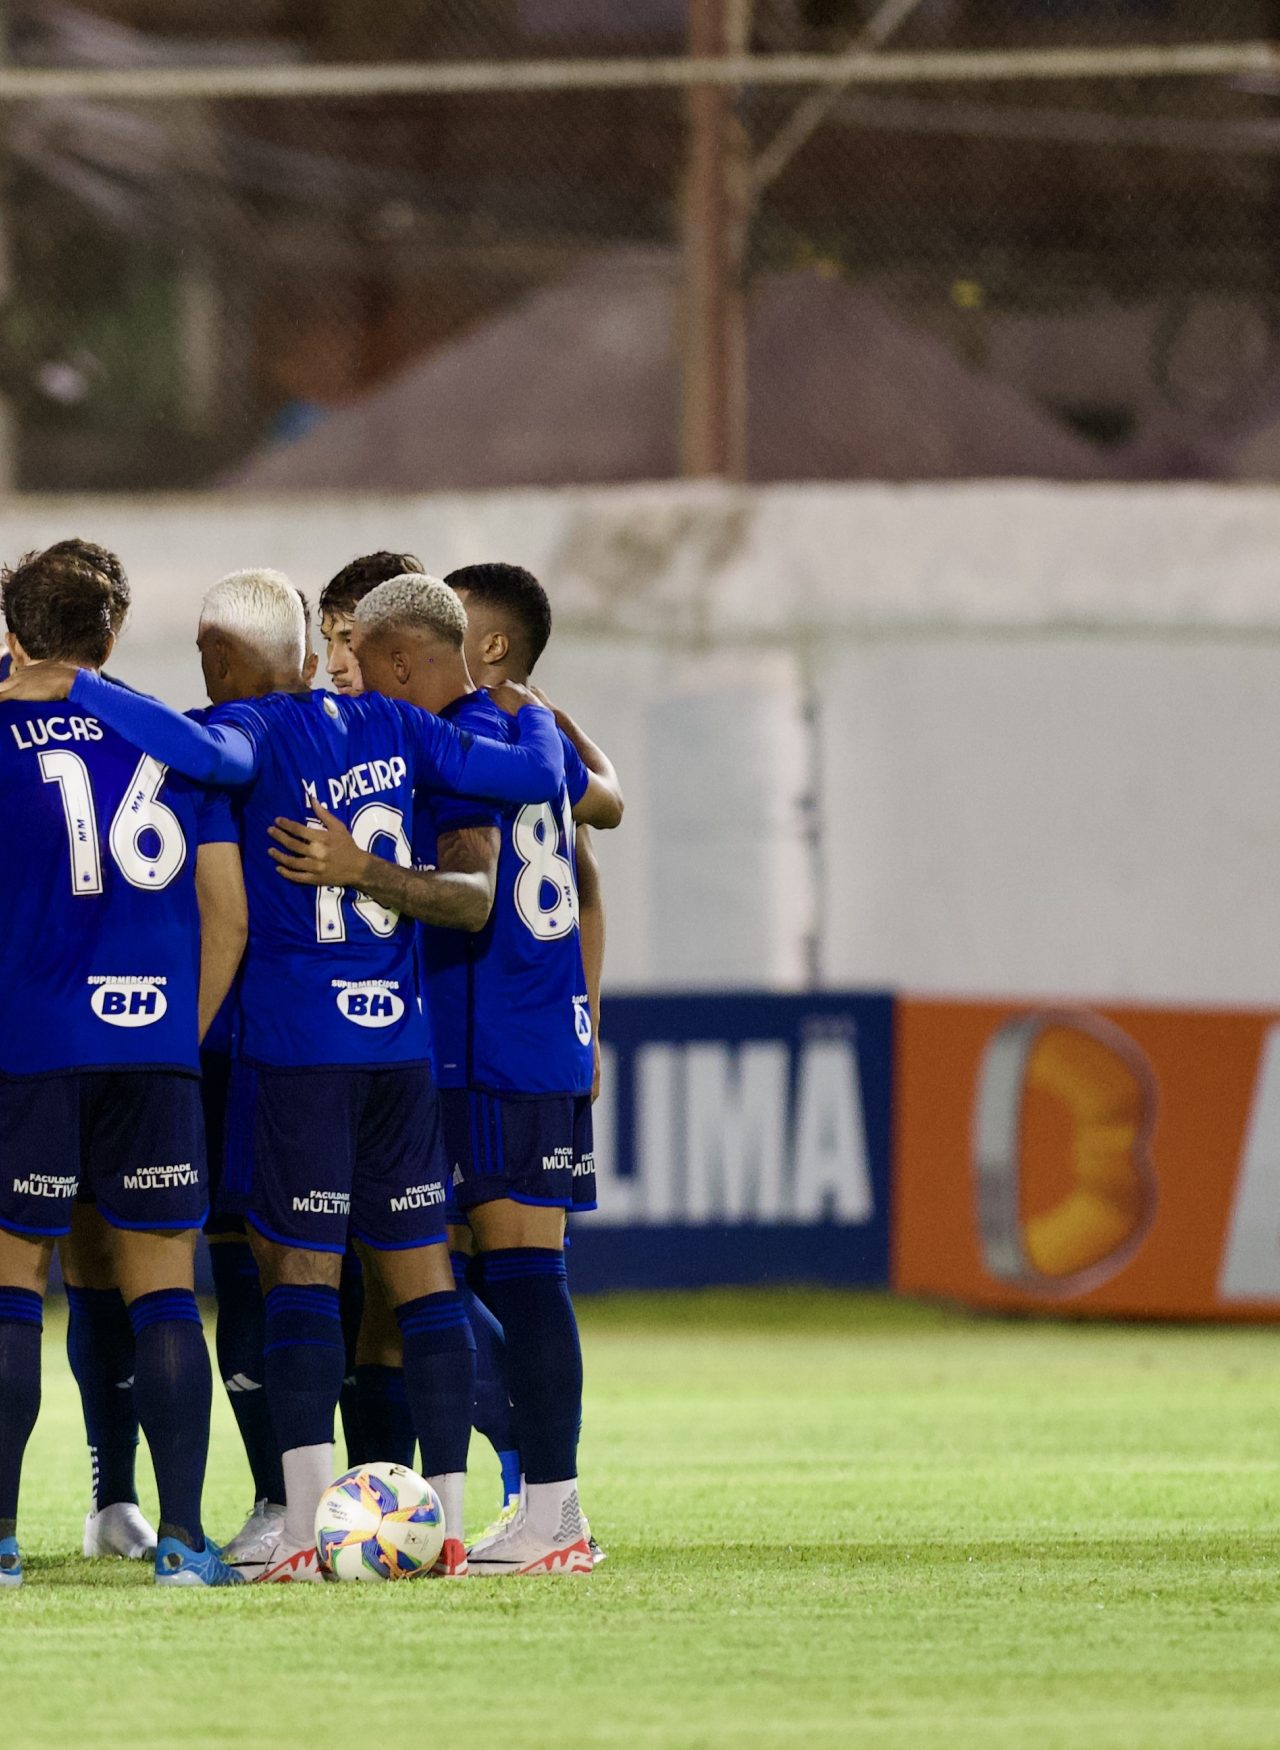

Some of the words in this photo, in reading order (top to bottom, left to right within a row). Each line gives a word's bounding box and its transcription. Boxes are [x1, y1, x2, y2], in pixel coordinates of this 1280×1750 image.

[10, 716, 104, 750] LUCAS
[37, 748, 187, 896] 16
[101, 991, 157, 1015] BH
[347, 993, 394, 1017] BH
[123, 1169, 200, 1189] MULTIVIX
[136, 1163, 192, 1175] FACULDADE
